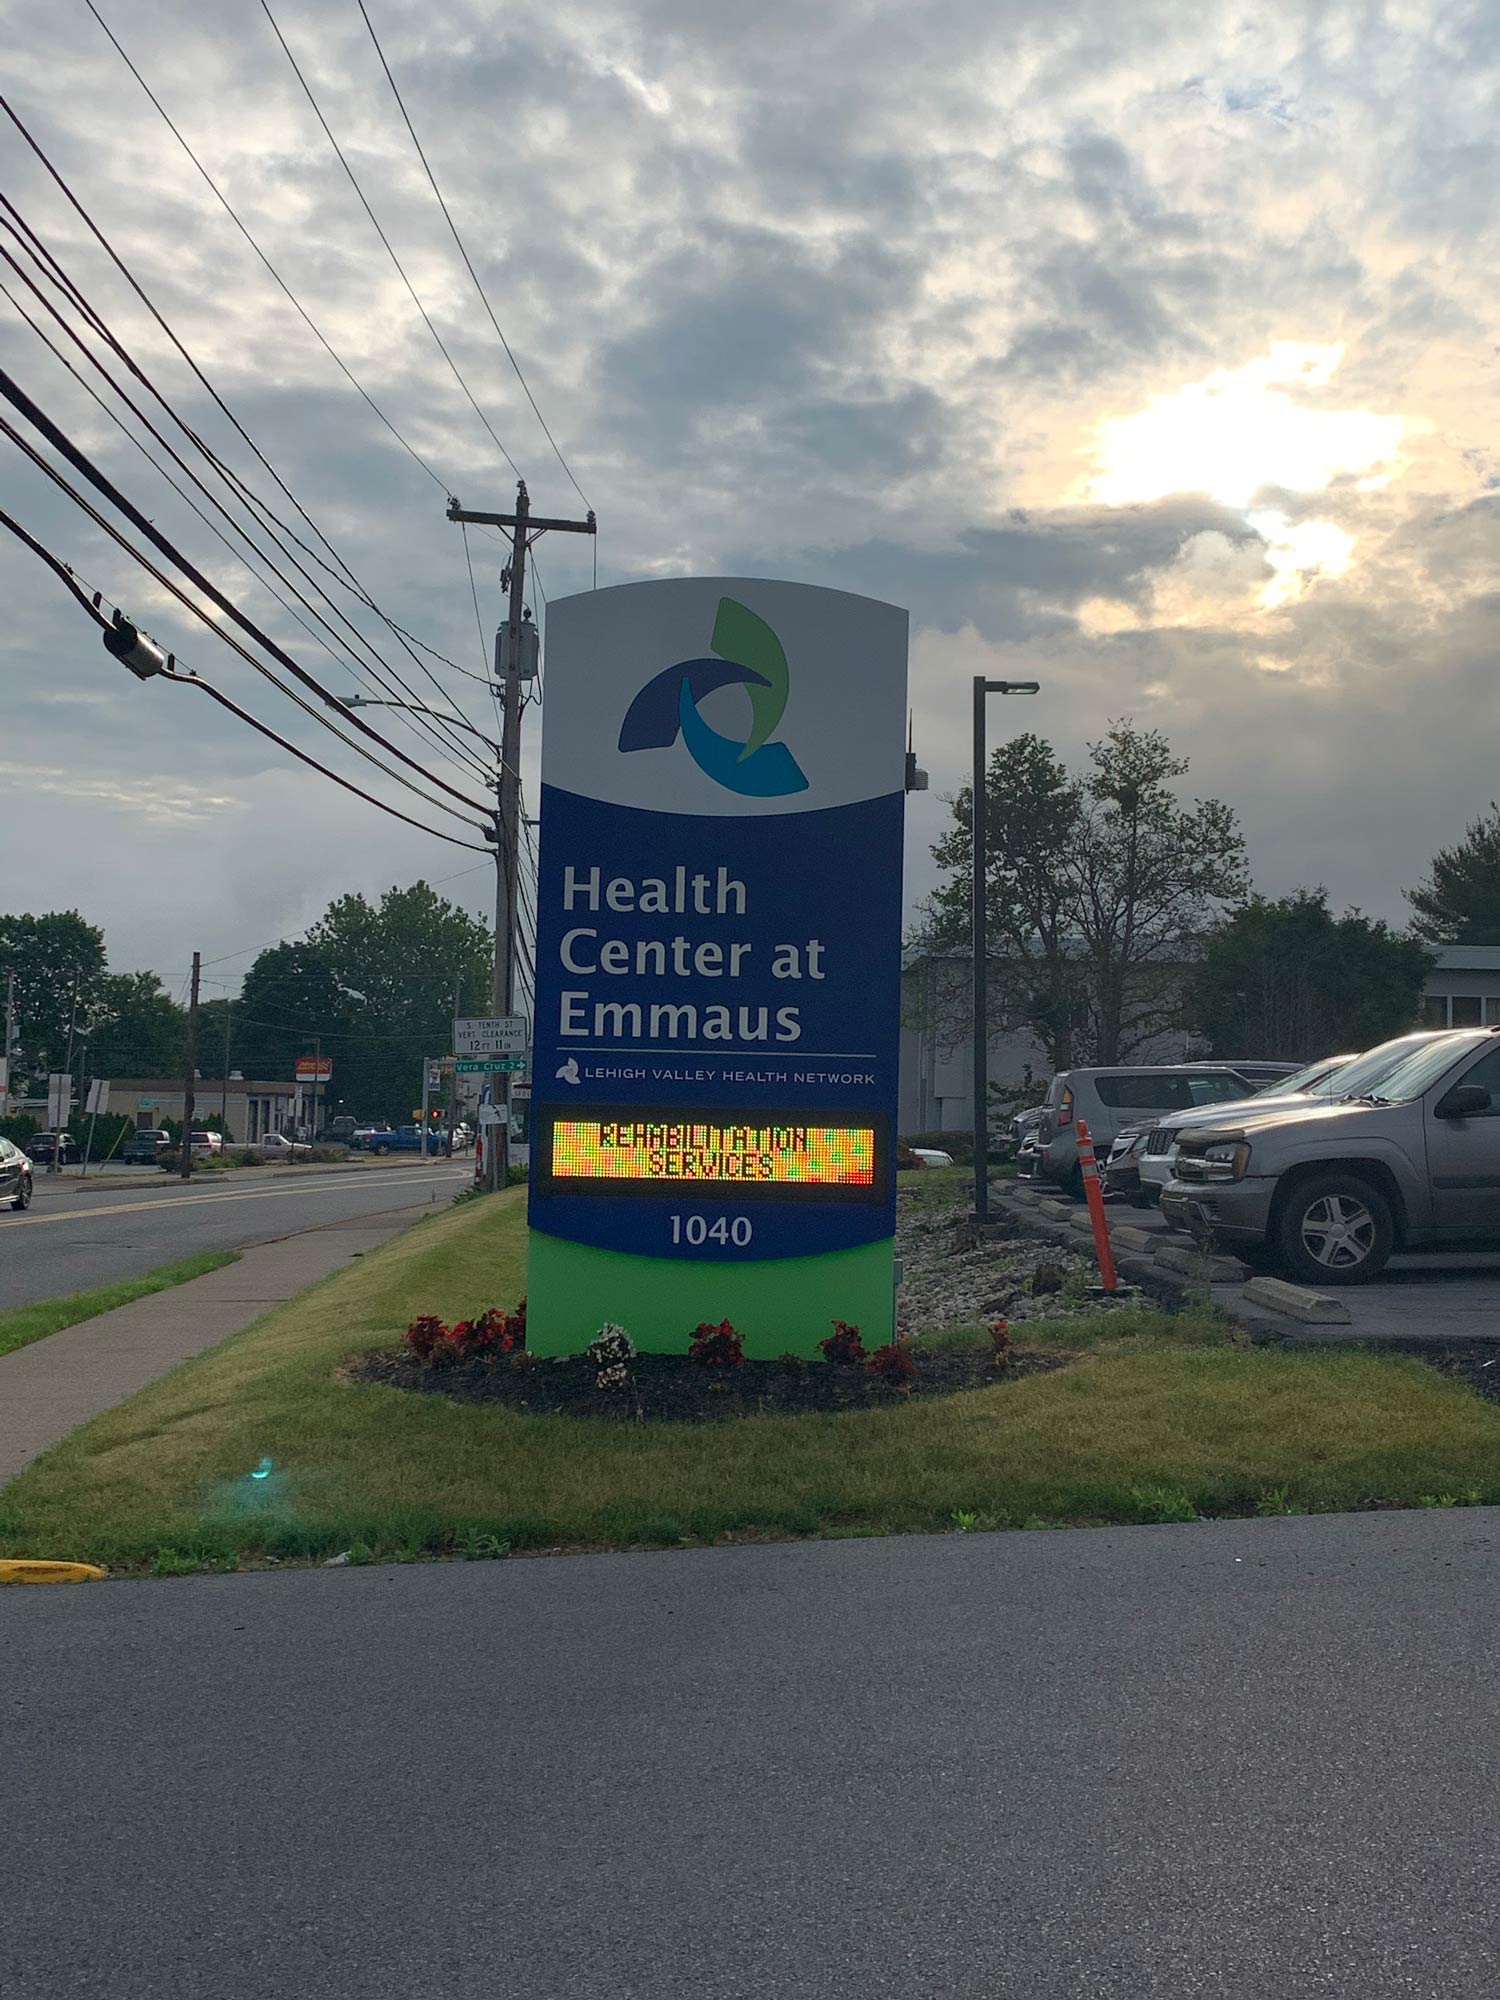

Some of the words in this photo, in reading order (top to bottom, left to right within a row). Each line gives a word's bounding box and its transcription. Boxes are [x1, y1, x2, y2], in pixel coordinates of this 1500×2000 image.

[563, 865, 747, 915] Health
[559, 927, 752, 978] Center
[771, 938, 826, 980] at
[479, 1021, 500, 1029] TENTH
[505, 1020, 513, 1028] ST
[559, 991, 802, 1042] Emmaus
[458, 1031, 476, 1039] VERT
[482, 1030, 523, 1038] CLEARANCE
[470, 1040, 480, 1051] 12
[495, 1040, 503, 1050] 11
[456, 1064, 479, 1072] Vera
[483, 1062, 506, 1070] Cruz
[508, 1062, 515, 1070] 2
[584, 1067, 646, 1079] LEHIGH
[652, 1069, 716, 1081] VALLEY
[722, 1071, 788, 1083] HEALTH
[794, 1072, 876, 1085] NETWORK
[600, 1123, 808, 1151] REHABILITATION
[649, 1151, 774, 1179] SERVICES
[669, 1215, 753, 1247] 1040
